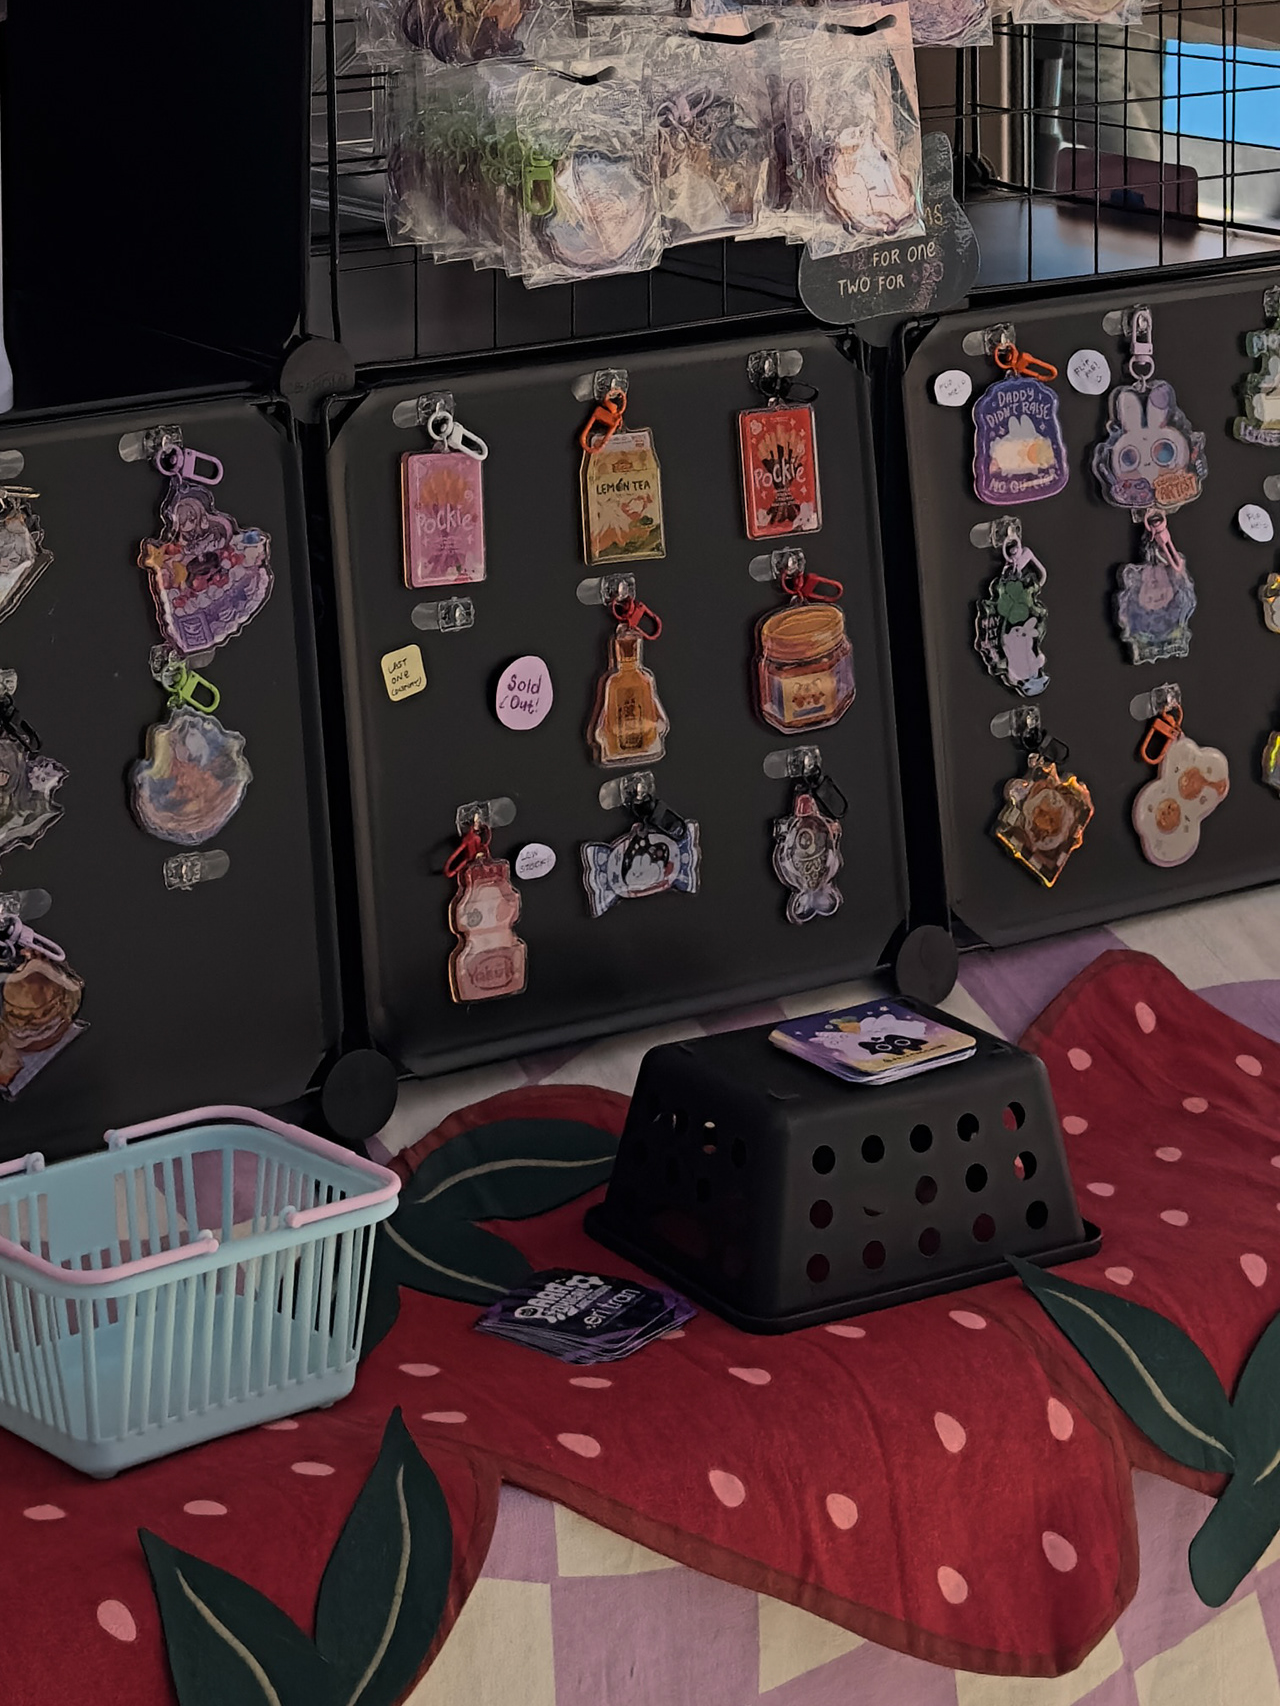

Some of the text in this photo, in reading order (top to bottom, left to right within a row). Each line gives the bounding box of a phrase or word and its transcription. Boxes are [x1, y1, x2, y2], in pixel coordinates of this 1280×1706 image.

[872, 248, 901, 267] FOR
[838, 277, 871, 296] TWO
[878, 273, 906, 294] FOR
[997, 387, 1035, 407] DADDY
[1021, 400, 1052, 421] RAISE
[595, 478, 651, 495] LEMON TEA
[388, 657, 408, 675] LAST
[507, 673, 542, 695] Sold
[510, 694, 539, 715] Out!
